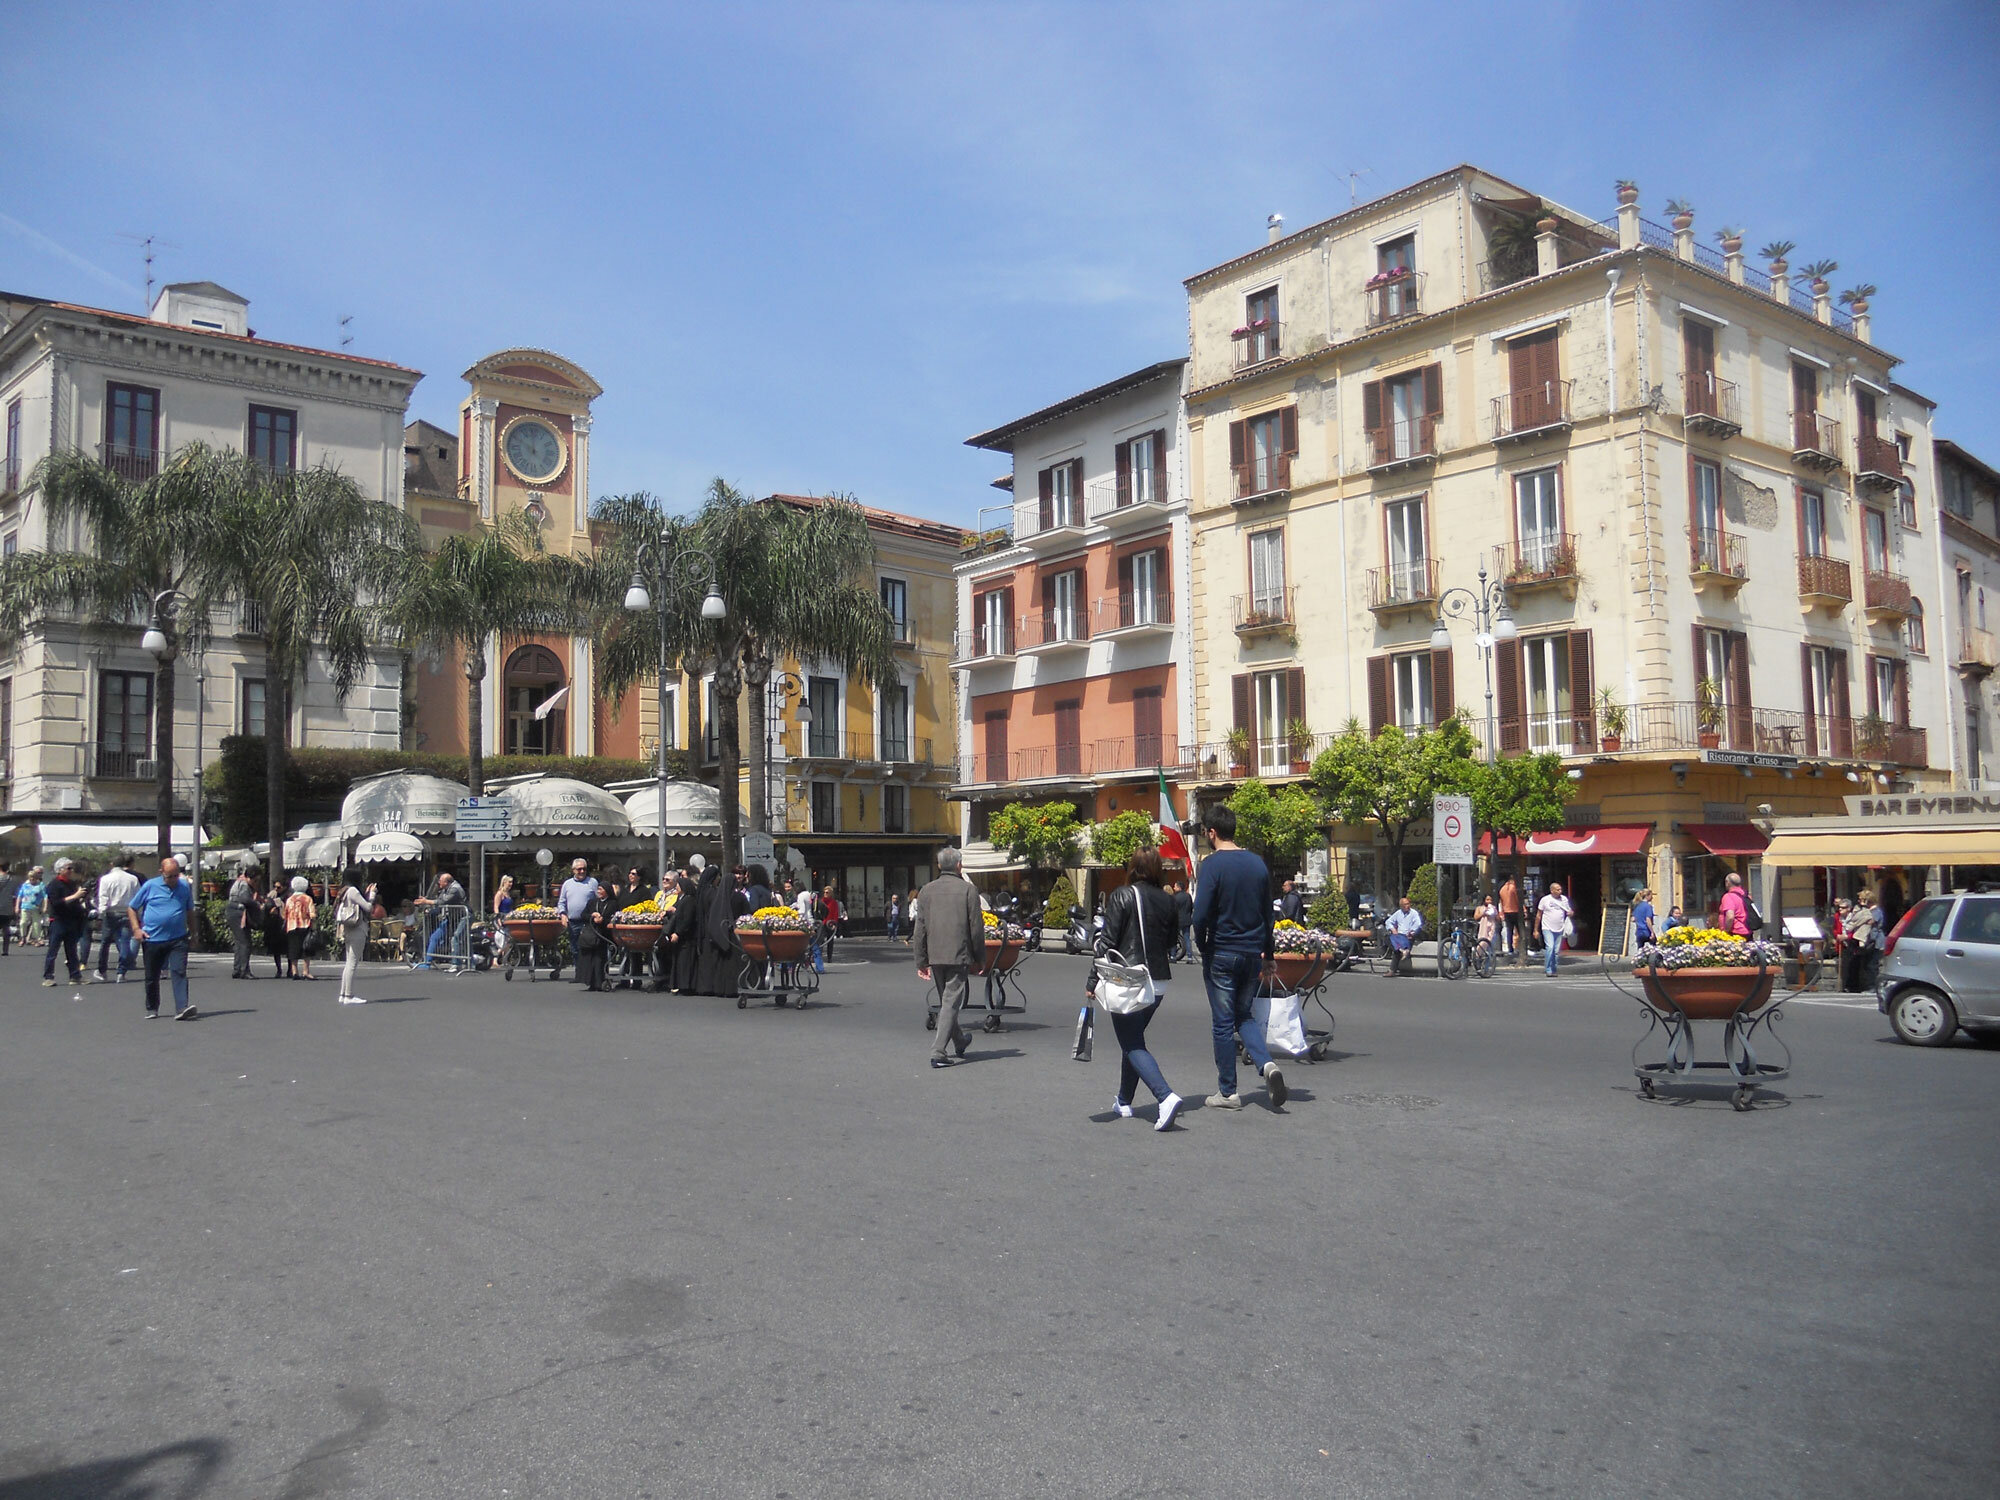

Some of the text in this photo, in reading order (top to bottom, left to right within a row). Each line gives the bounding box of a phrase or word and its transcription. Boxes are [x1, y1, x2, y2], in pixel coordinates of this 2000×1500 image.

[1709, 751, 1749, 764] Ristorante
[1753, 755, 1779, 766] Caruso
[562, 794, 585, 802] BAR
[1860, 799, 1902, 816] BAR
[384, 811, 402, 821] BAR
[552, 808, 600, 820] Ercolano
[371, 844, 390, 852] BAR
